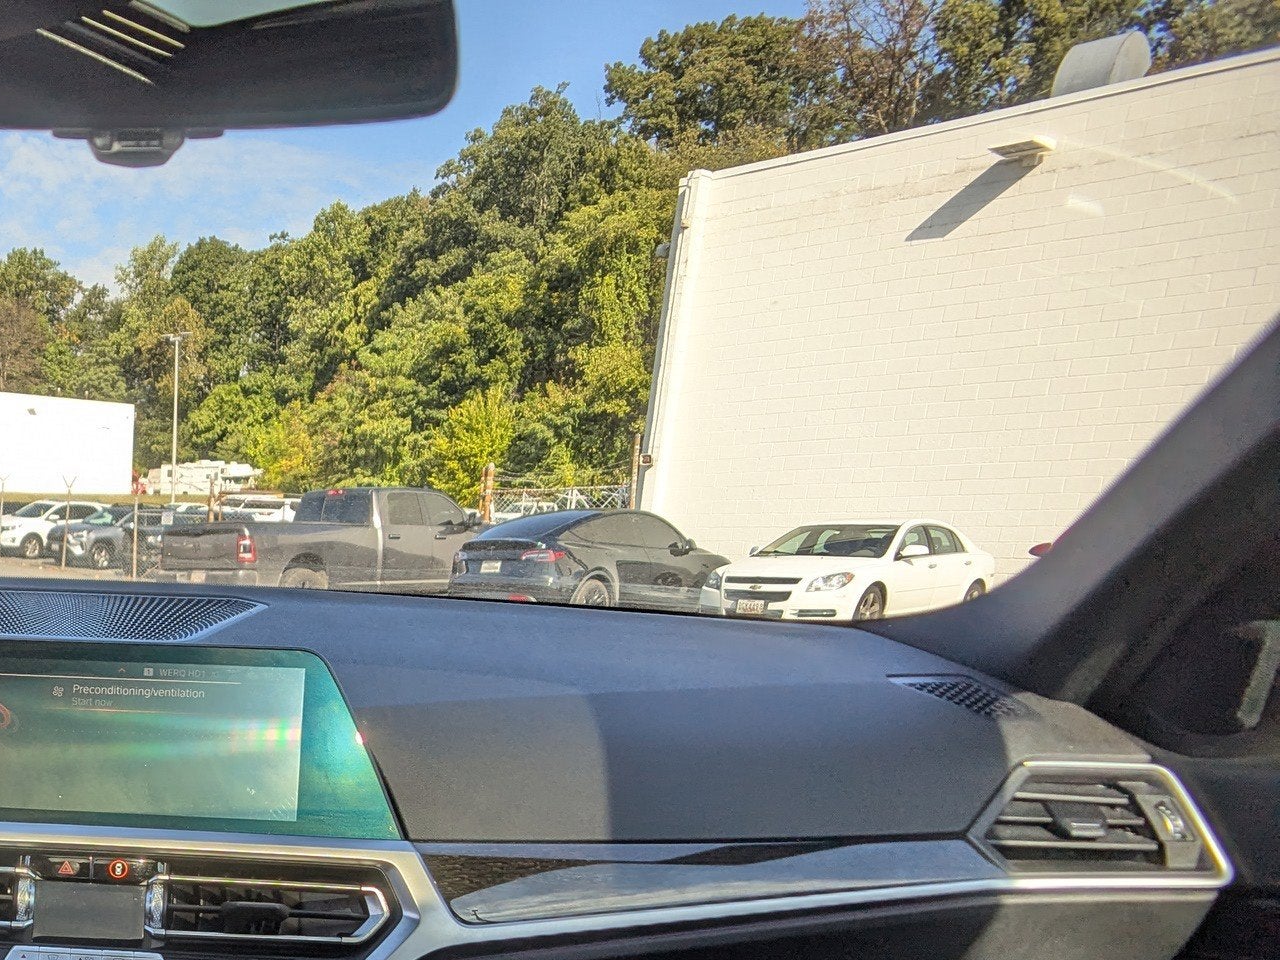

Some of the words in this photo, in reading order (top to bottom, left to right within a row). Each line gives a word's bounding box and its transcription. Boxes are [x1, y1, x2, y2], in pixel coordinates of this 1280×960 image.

[73, 684, 205, 699] Preconditioning/ventilation
[72, 697, 92, 706] Start
[94, 699, 113, 707] now
